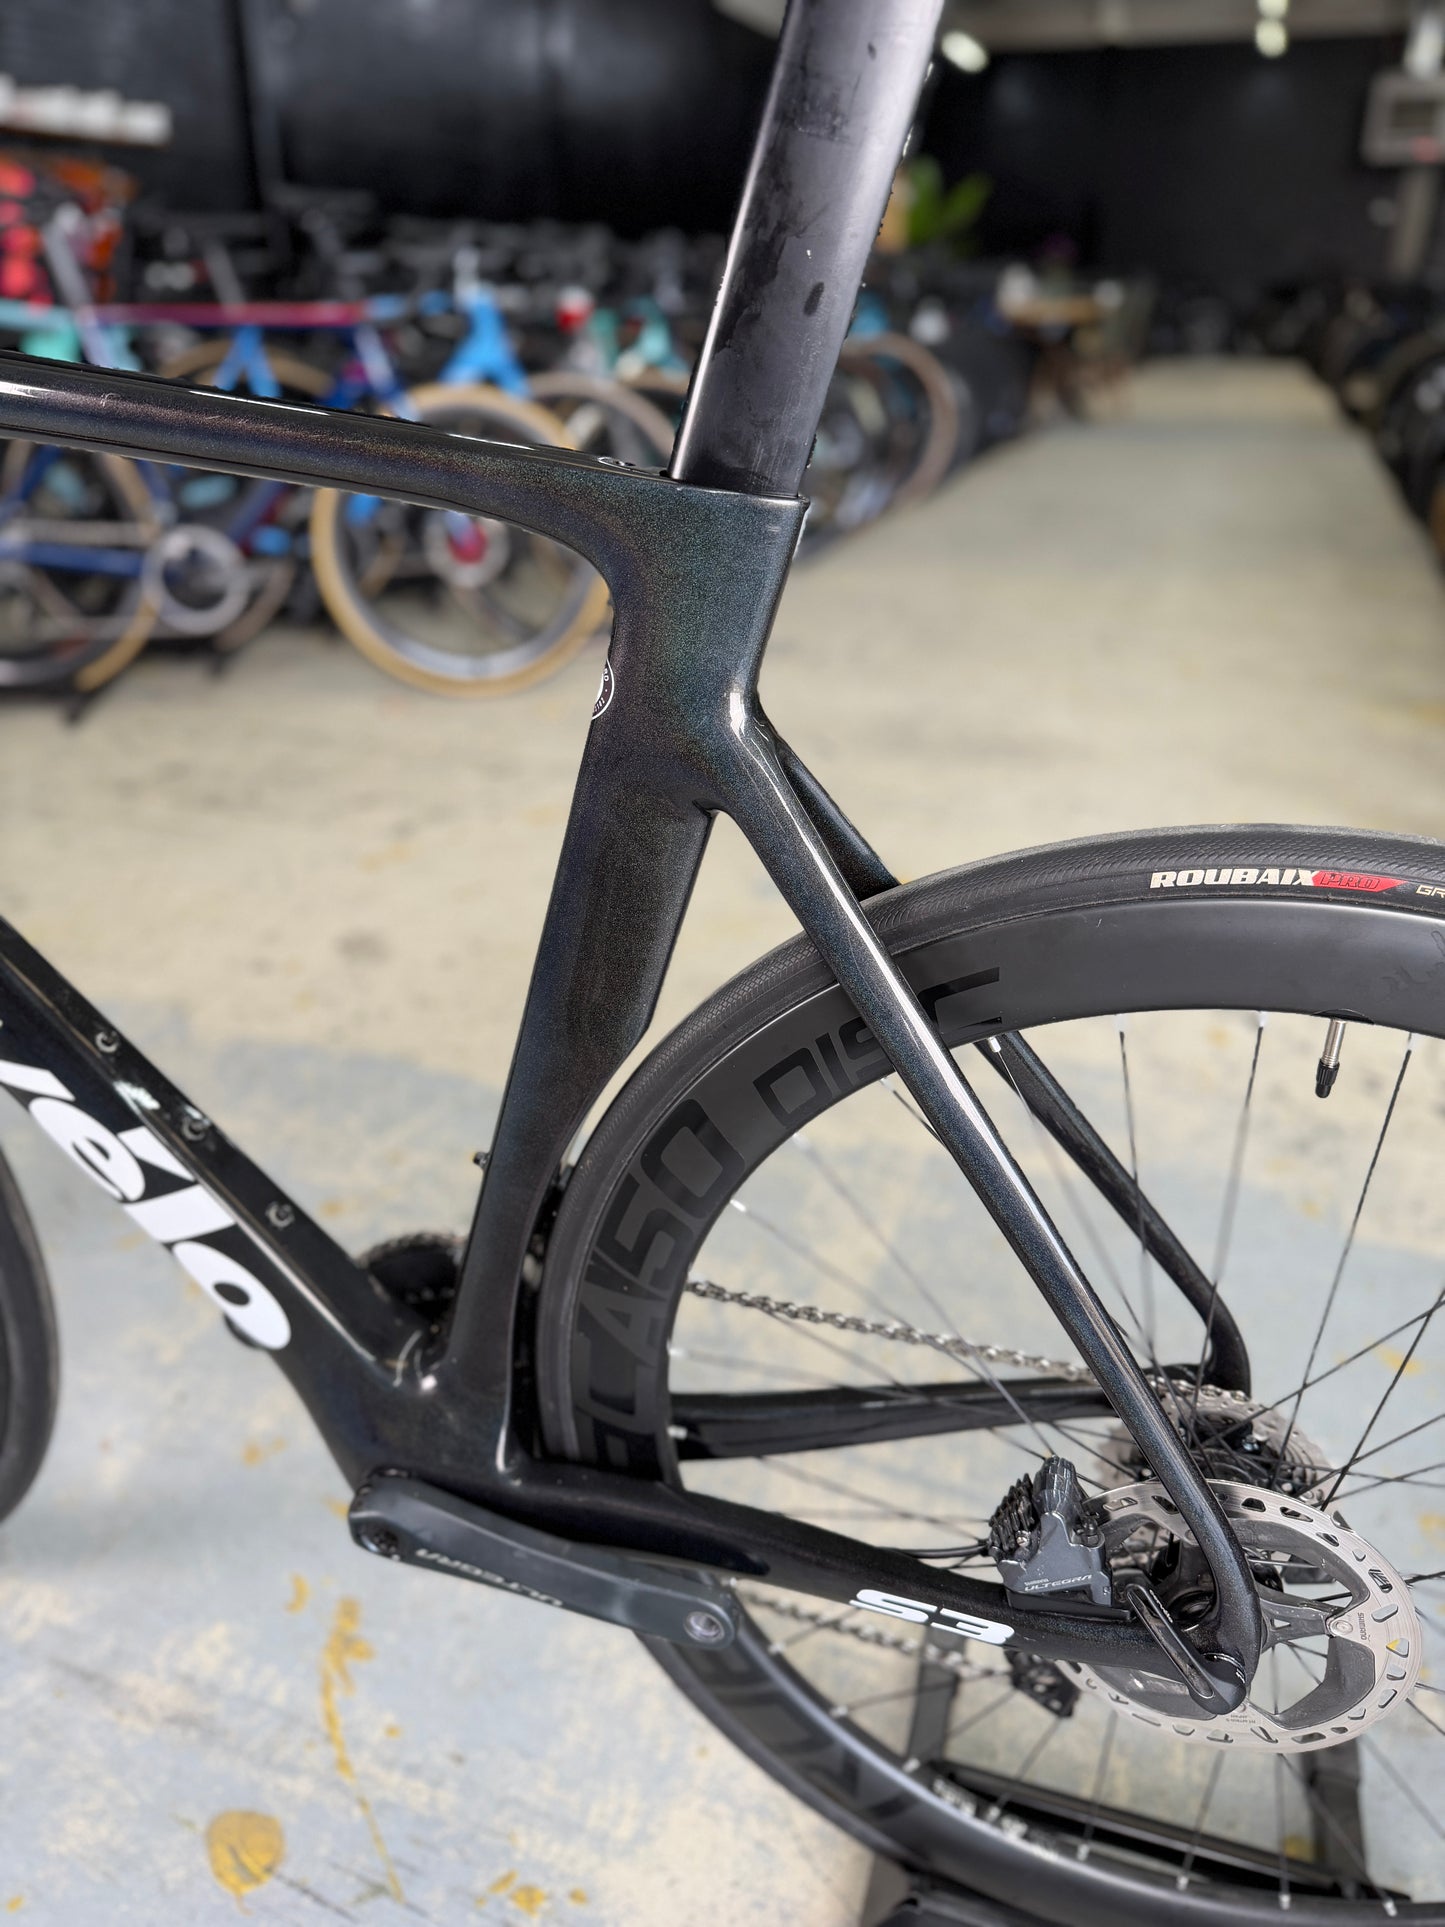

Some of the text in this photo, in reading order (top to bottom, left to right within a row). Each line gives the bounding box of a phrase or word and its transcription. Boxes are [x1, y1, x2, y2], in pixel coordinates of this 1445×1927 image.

[1149, 868, 1321, 889] ROUBAIX
[1320, 872, 1381, 891] PRO
[1024, 1574, 1093, 1592] ULTEGRA
[849, 1588, 1015, 1645] S3
